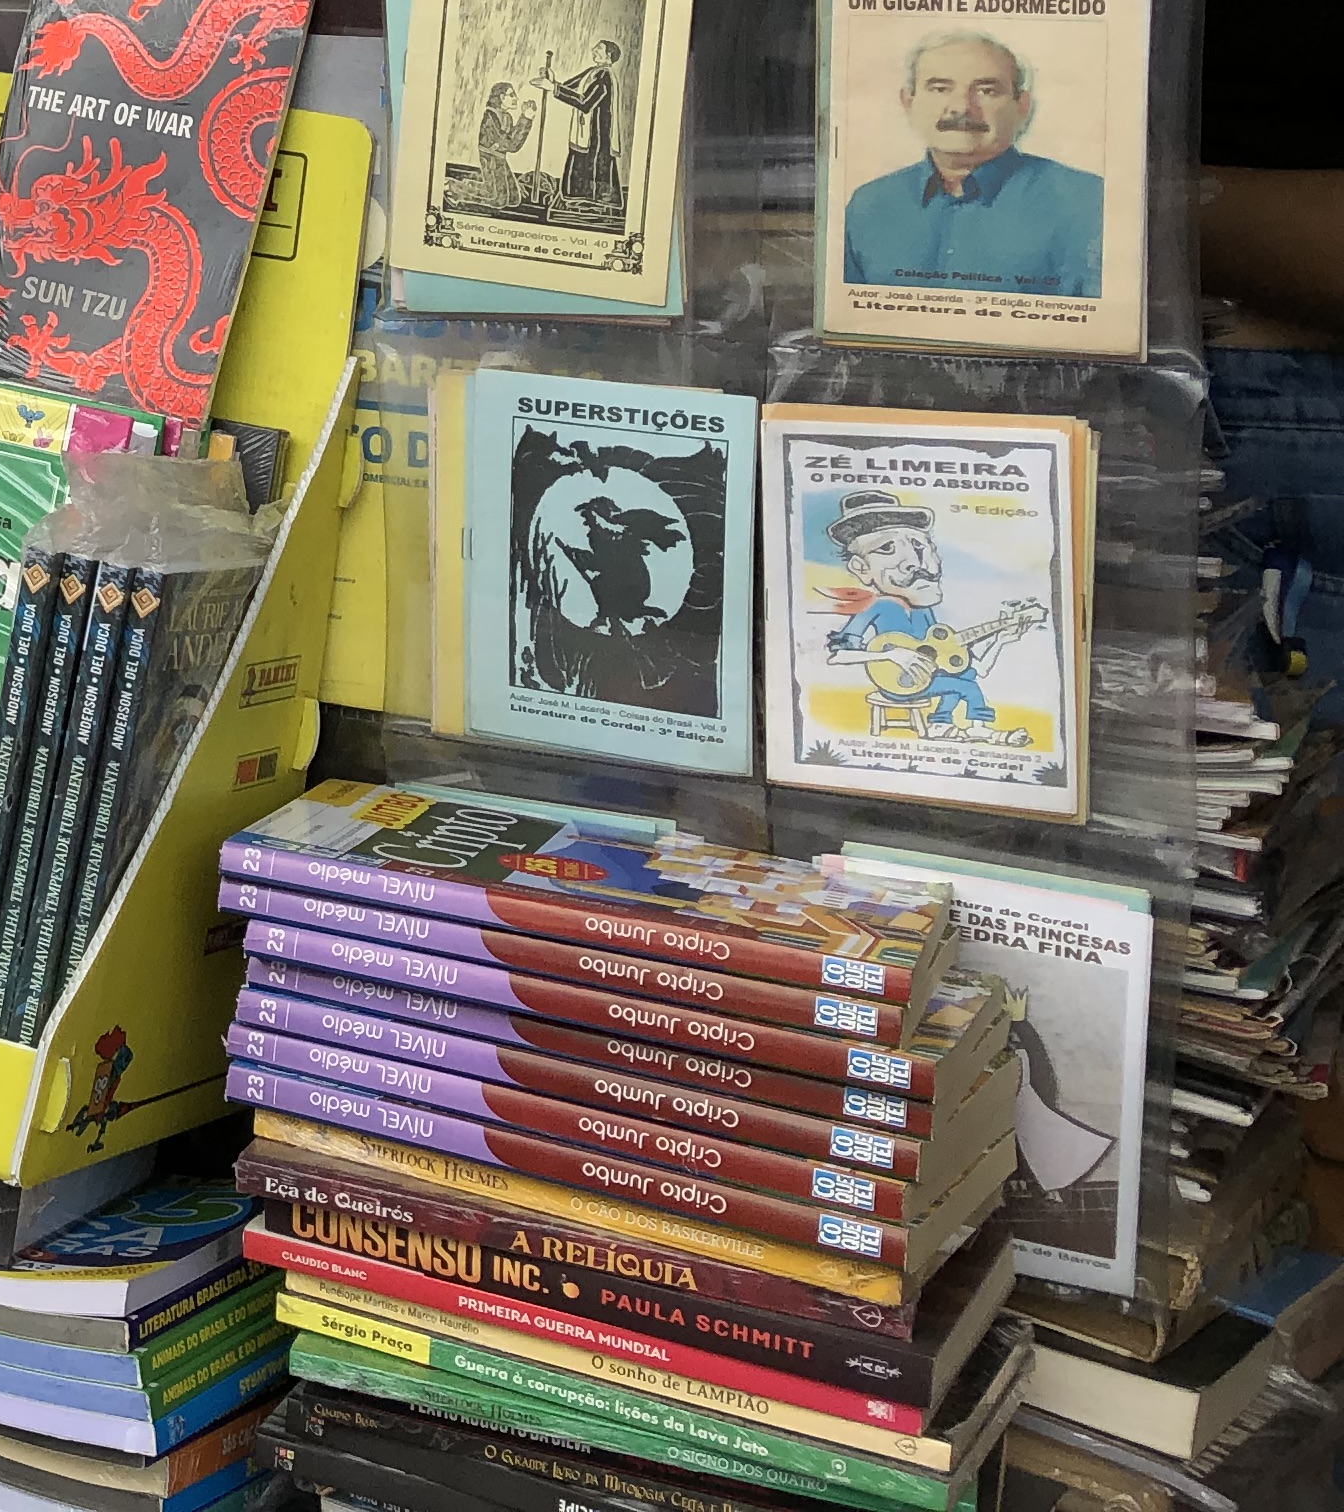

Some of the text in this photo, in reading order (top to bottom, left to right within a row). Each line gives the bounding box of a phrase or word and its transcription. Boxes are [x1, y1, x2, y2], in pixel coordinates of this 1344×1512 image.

[27, 84, 194, 139] THE ART OF WAR
[470, 237, 593, 260] Literatura Cordel
[22, 275, 127, 323] SUN TZU
[516, 396, 725, 434] SUPERSTIÇÕES
[805, 455, 1028, 479] ZÉ LIMEIRA
[829, 472, 1030, 493] POETA DO ABSURDO
[975, 504, 1038, 521] Edição
[308, 861, 435, 902] NÍVEL médio
[584, 916, 730, 962] Cripto Jumbo
[1014, 921, 1132, 955] PRINCESAS
[1038, 944, 1103, 966] FINA
[264, 1176, 414, 1224] Eça de Queirós
[282, 1250, 367, 1281] CLAUDIO BLANC
[492, 1256, 549, 1294] INC.
[510, 1229, 698, 1291] A RELÍQUIA
[320, 1313, 413, 1356] Sérgio Praça
[458, 1294, 671, 1362] PRIMEIRA GUERRA MUNDIAL
[601, 1288, 815, 1360] PAULA SCHMITT
[455, 1353, 770, 1458] Guerra corrupção: lições da Lava Jato
